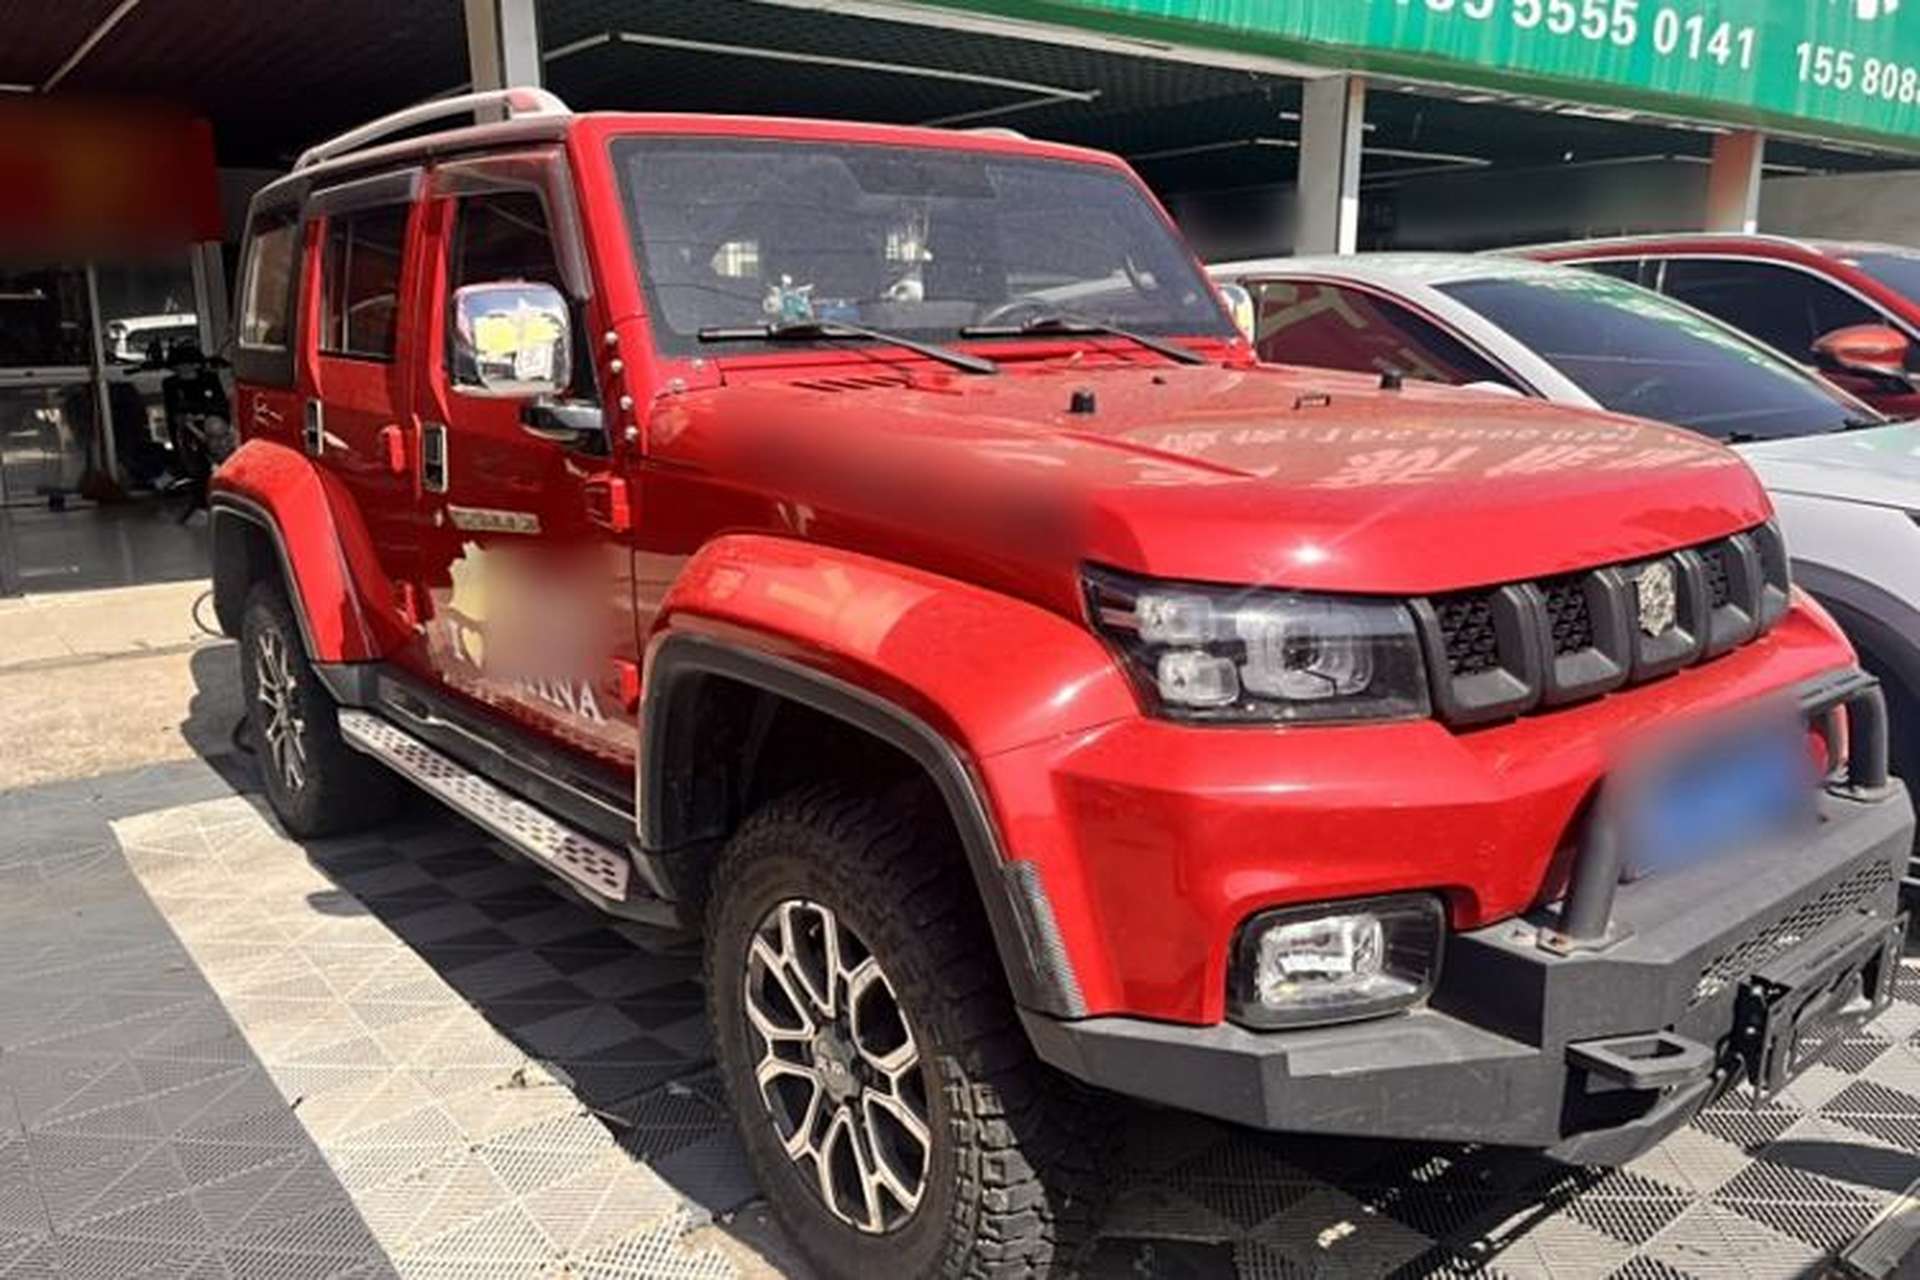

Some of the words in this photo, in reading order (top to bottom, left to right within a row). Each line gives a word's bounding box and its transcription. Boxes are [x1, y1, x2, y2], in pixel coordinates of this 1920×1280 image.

[1512, 0, 1639, 46] 5555
[1653, 8, 1755, 70] 0141
[1796, 41, 1855, 90] 155
[1861, 57, 1920, 104] 808
